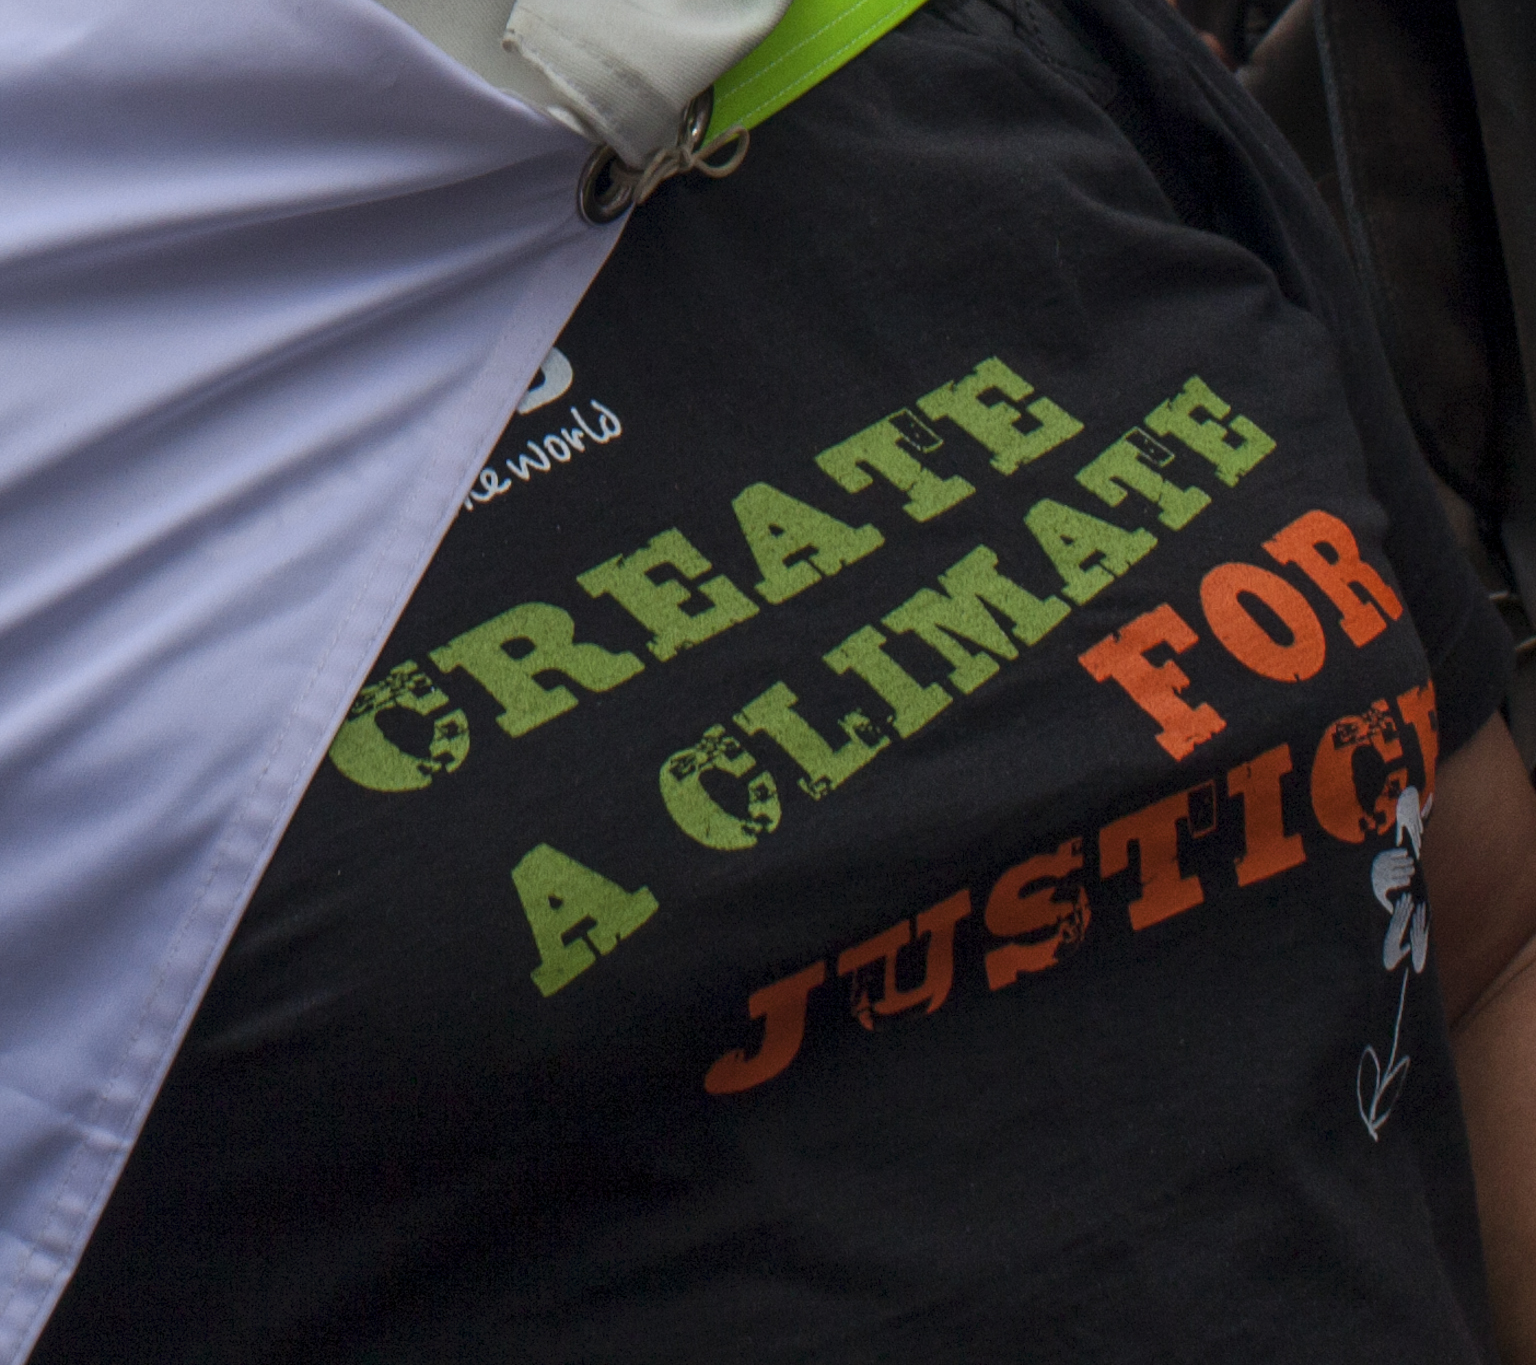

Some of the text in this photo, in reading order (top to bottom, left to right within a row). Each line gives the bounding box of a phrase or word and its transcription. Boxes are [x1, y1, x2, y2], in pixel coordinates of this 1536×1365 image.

[328, 355, 1085, 794] CREATE
[509, 374, 1278, 999] A CLIMATE
[1078, 508, 1405, 763] FOR
